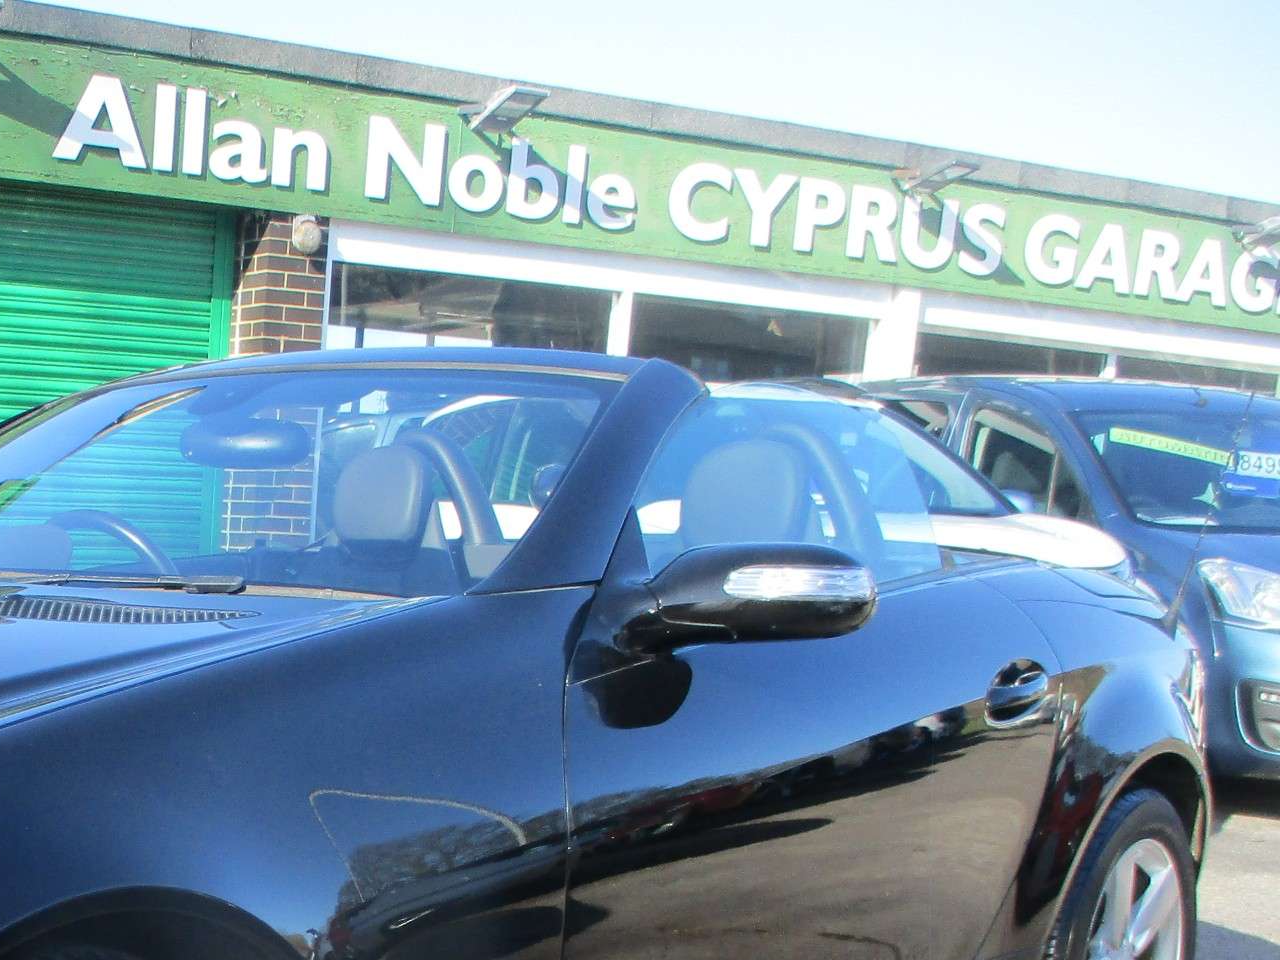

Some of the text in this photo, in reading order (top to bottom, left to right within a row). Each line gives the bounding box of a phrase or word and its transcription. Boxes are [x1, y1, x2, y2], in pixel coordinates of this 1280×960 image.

[52, 74, 1280, 314] Allan Noble CYPRUS GARAG
[1240, 454, 1280, 475] 849
